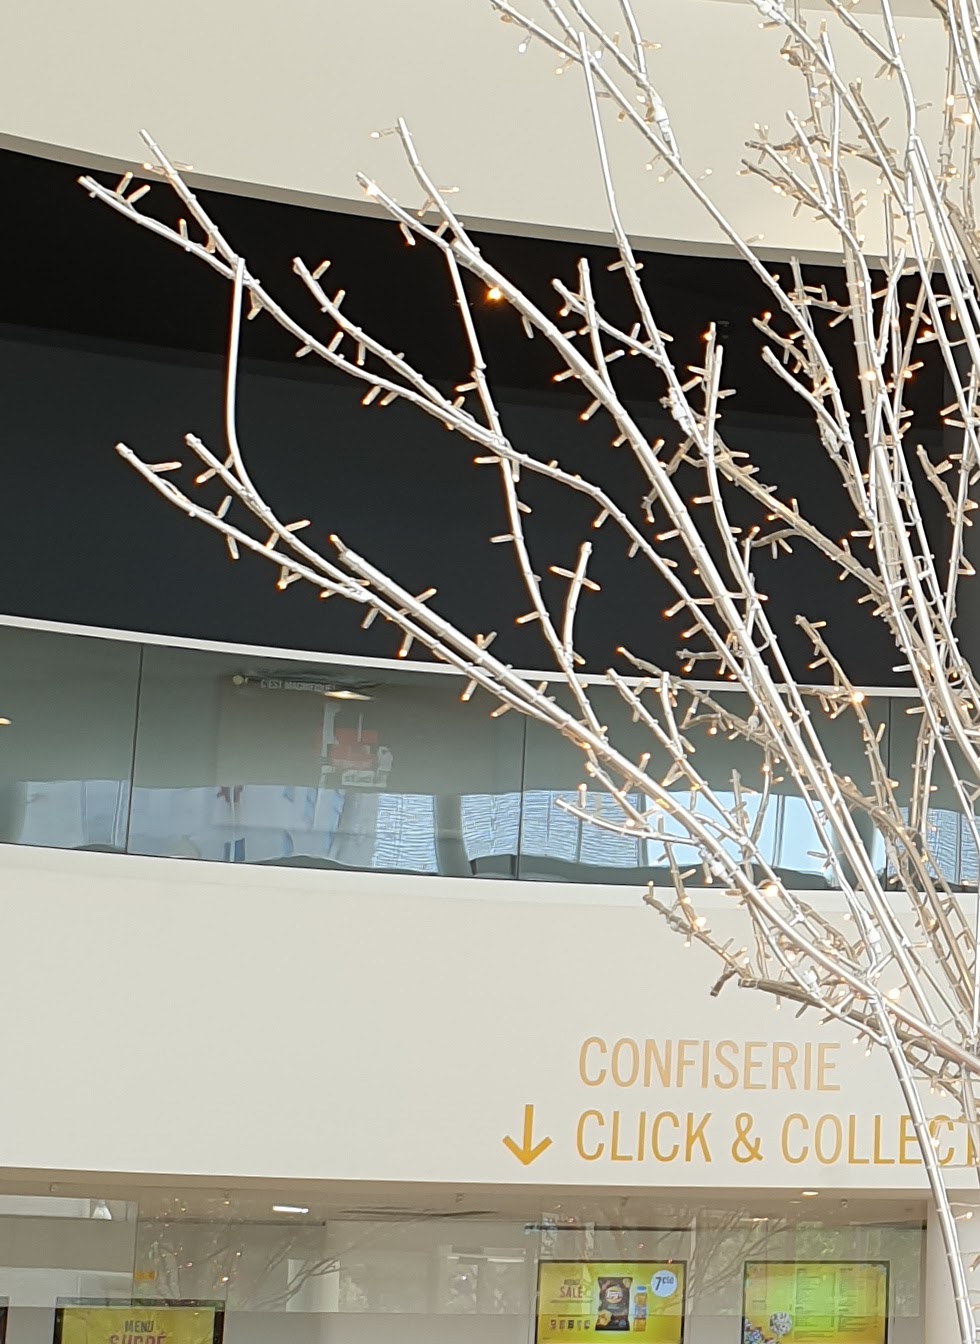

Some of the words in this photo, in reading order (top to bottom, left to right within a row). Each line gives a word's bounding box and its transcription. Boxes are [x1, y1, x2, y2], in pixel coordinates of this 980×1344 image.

[578, 1036, 841, 1091] CONFISERIE
[576, 1109, 712, 1163] CLICK
[730, 1112, 763, 1164] &
[781, 1112, 980, 1167] COLLECT
[124, 1320, 154, 1333] MENU
